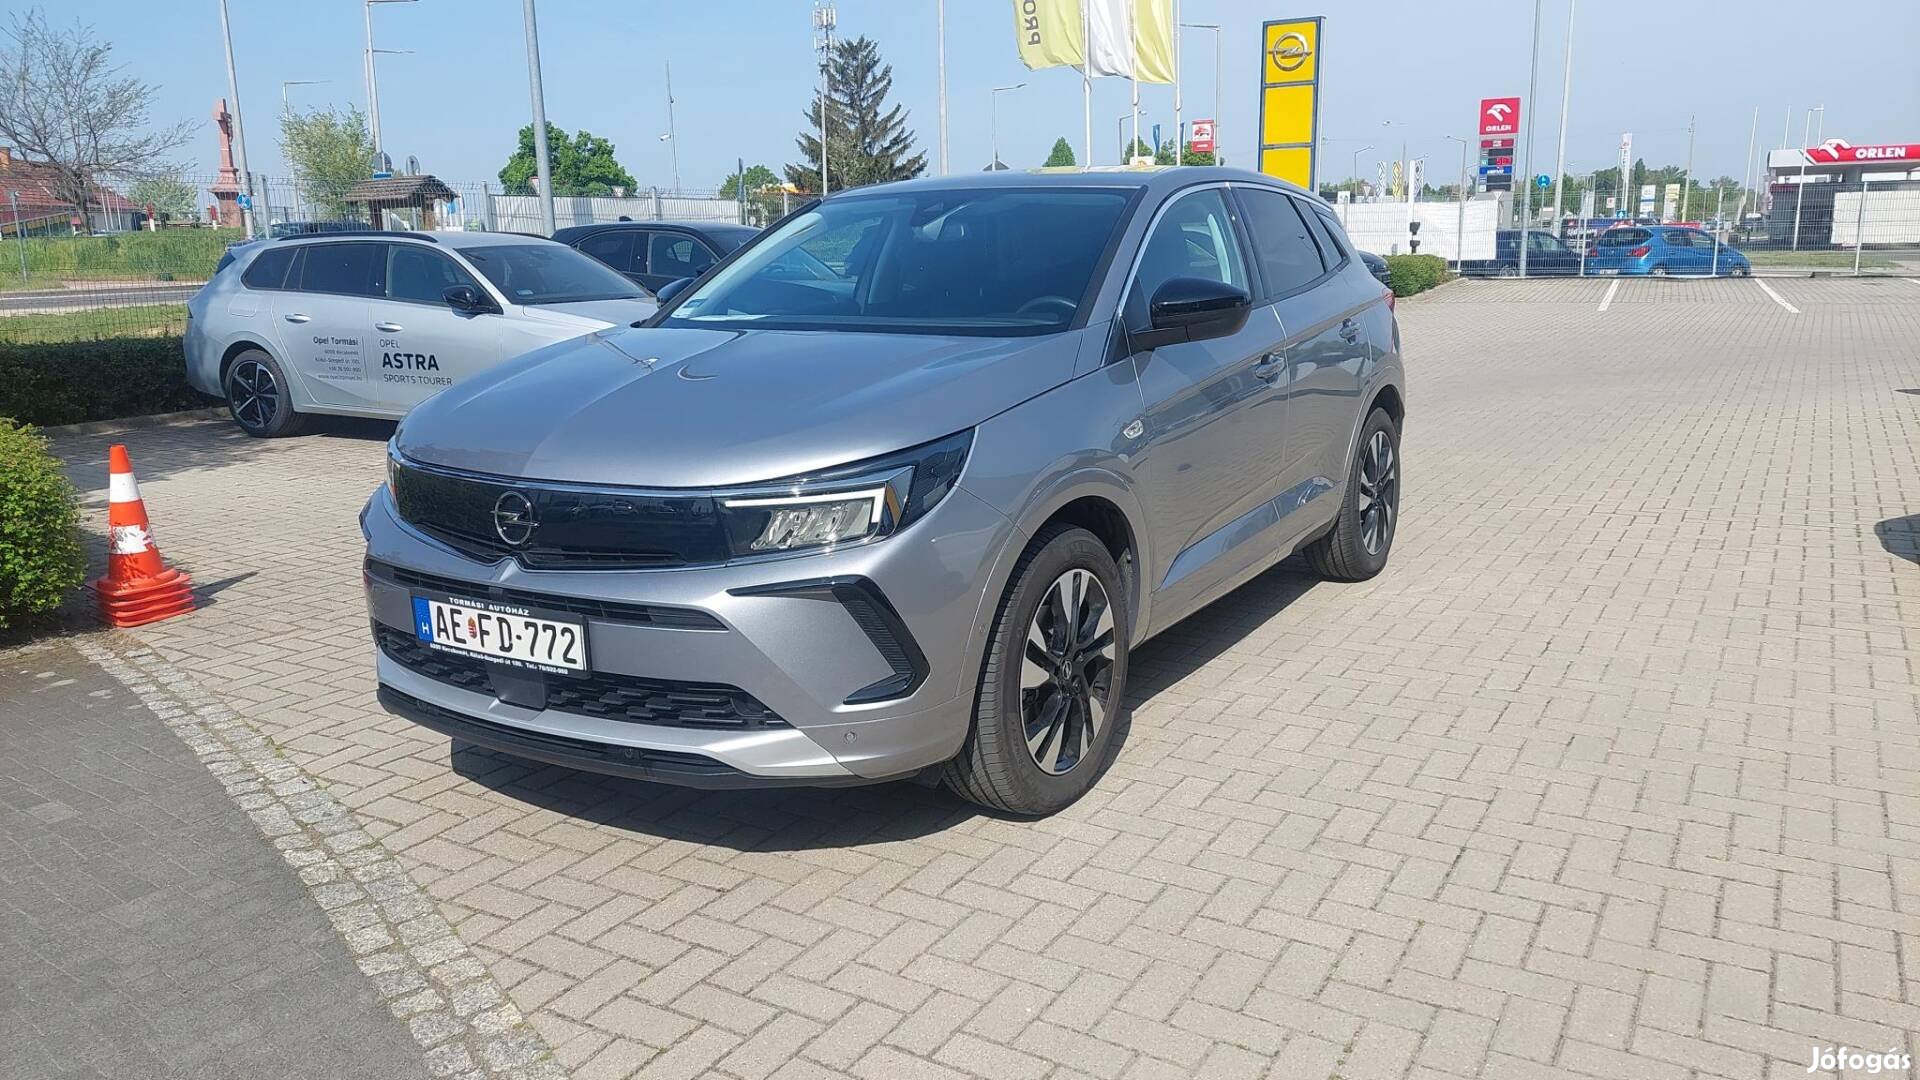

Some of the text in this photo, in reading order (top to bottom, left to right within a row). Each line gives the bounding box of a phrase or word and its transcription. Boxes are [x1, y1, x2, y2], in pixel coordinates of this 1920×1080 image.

[1855, 147, 1906, 159] ORLEN
[313, 336, 329, 346] Opel
[379, 338, 400, 348] OPEL
[382, 352, 440, 371] ASTRA
[383, 373, 453, 386] SPORTS TOURER
[448, 597, 530, 616] TORMÁSI AUTÓHÁZ
[421, 622, 430, 635] H
[436, 605, 578, 665] AE FD-772
